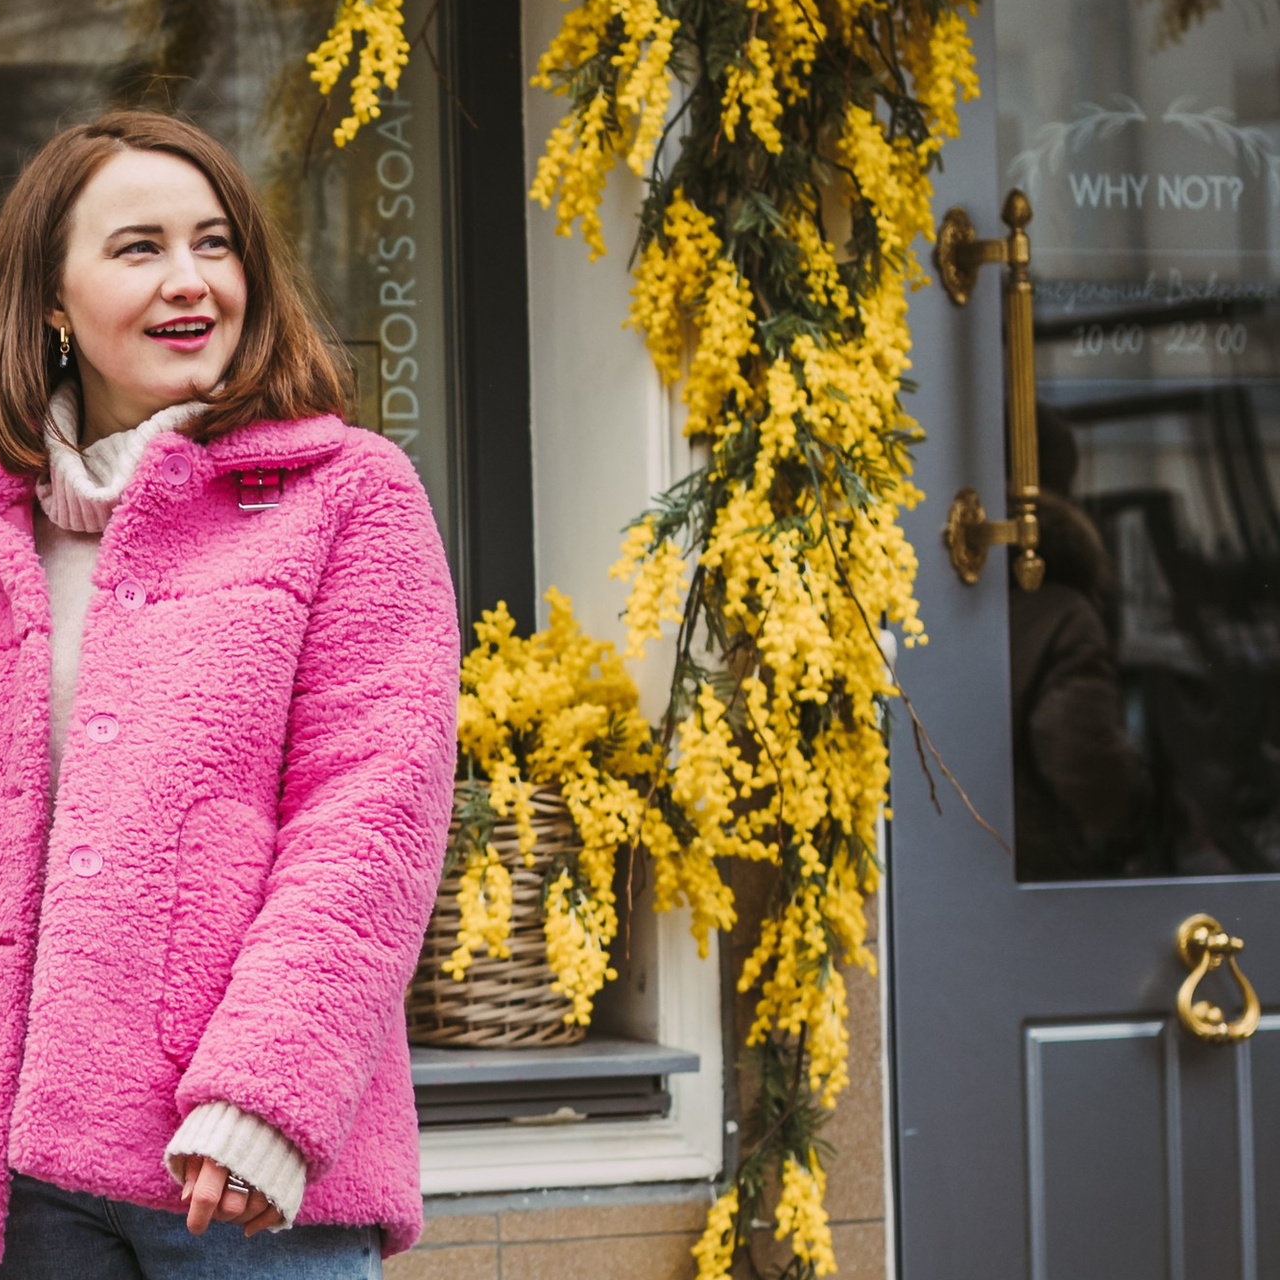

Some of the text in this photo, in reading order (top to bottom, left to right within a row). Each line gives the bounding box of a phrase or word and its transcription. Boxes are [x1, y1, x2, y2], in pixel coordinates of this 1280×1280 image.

[1070, 173, 1244, 211] WHY NOT?
[377, 235, 420, 464] NDSOR'S
